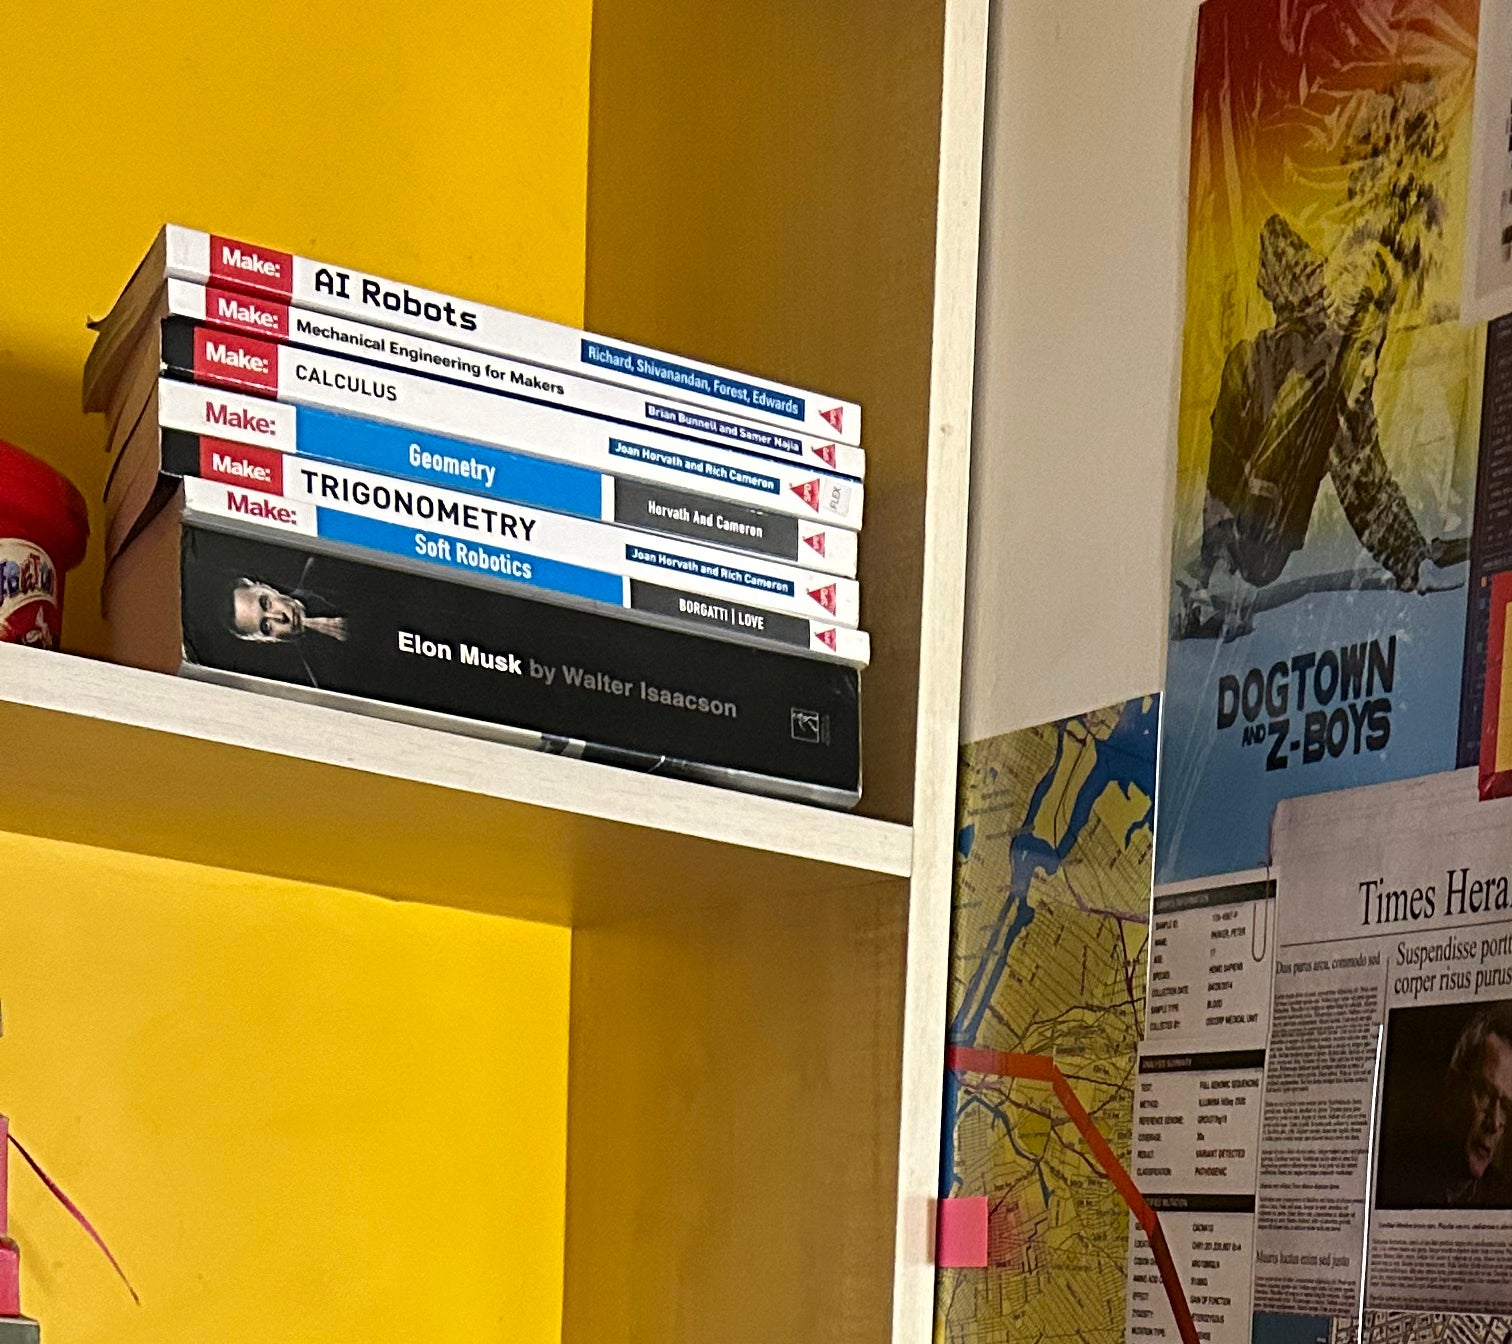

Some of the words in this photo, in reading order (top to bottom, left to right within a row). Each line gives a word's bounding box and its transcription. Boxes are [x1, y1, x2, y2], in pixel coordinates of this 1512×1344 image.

[223, 247, 281, 277] Make:
[219, 298, 278, 328] Make:
[315, 269, 349, 299] AI
[363, 279, 477, 331] Robots
[206, 341, 269, 373] Make:
[297, 319, 385, 352] Mechanical
[390, 343, 480, 377] Engineering
[485, 365, 506, 380] for
[510, 371, 565, 395] Makers
[296, 365, 397, 400] CALCULUS
[588, 346, 634, 372] Richard,
[637, 359, 711, 392] Shivanandan,
[714, 380, 750, 403] Forest,
[752, 391, 799, 414] Edwards
[206, 402, 276, 435] Make:
[648, 405, 676, 421] Brian
[679, 413, 716, 431] Bunnell
[719, 423, 738, 435] and
[740, 427, 772, 445] Samer
[212, 453, 271, 482] Make:
[409, 444, 496, 486] Geometry
[615, 442, 639, 457] Joan
[642, 448, 682, 468] Horvath
[685, 458, 703, 472] and
[706, 461, 726, 477] Rich
[729, 469, 774, 490] Cameron
[227, 491, 297, 524] Make:
[301, 469, 536, 541] TRIGONOMETRY
[830, 487, 841, 509] FLEX
[648, 501, 690, 523] Horvath
[694, 511, 713, 527] And
[716, 516, 763, 538] Cameron
[415, 534, 451, 561] Soft
[456, 542, 532, 578] Robotics
[631, 548, 656, 562] Joan
[658, 553, 698, 572] Horvath
[701, 563, 718, 577] and
[721, 567, 742, 582] Rich
[744, 574, 788, 593] Cameron
[679, 598, 728, 621] BORGATTI
[738, 612, 764, 630] LOVE
[399, 631, 451, 661] Elon
[460, 644, 522, 675] Musk
[530, 659, 556, 685] by
[563, 666, 634, 696] Walter
[641, 681, 736, 718] Isaacson
[1217, 635, 1396, 730] DOGTOWN
[1242, 723, 1265, 747] AND
[1266, 698, 1391, 772] Z-BOYS
[1360, 878, 1435, 925] Times
[1396, 935, 1477, 967] Suspendisse
[1394, 969, 1436, 998] corper
[1439, 963, 1473, 991] risus
[1475, 961, 1512, 992] purus
